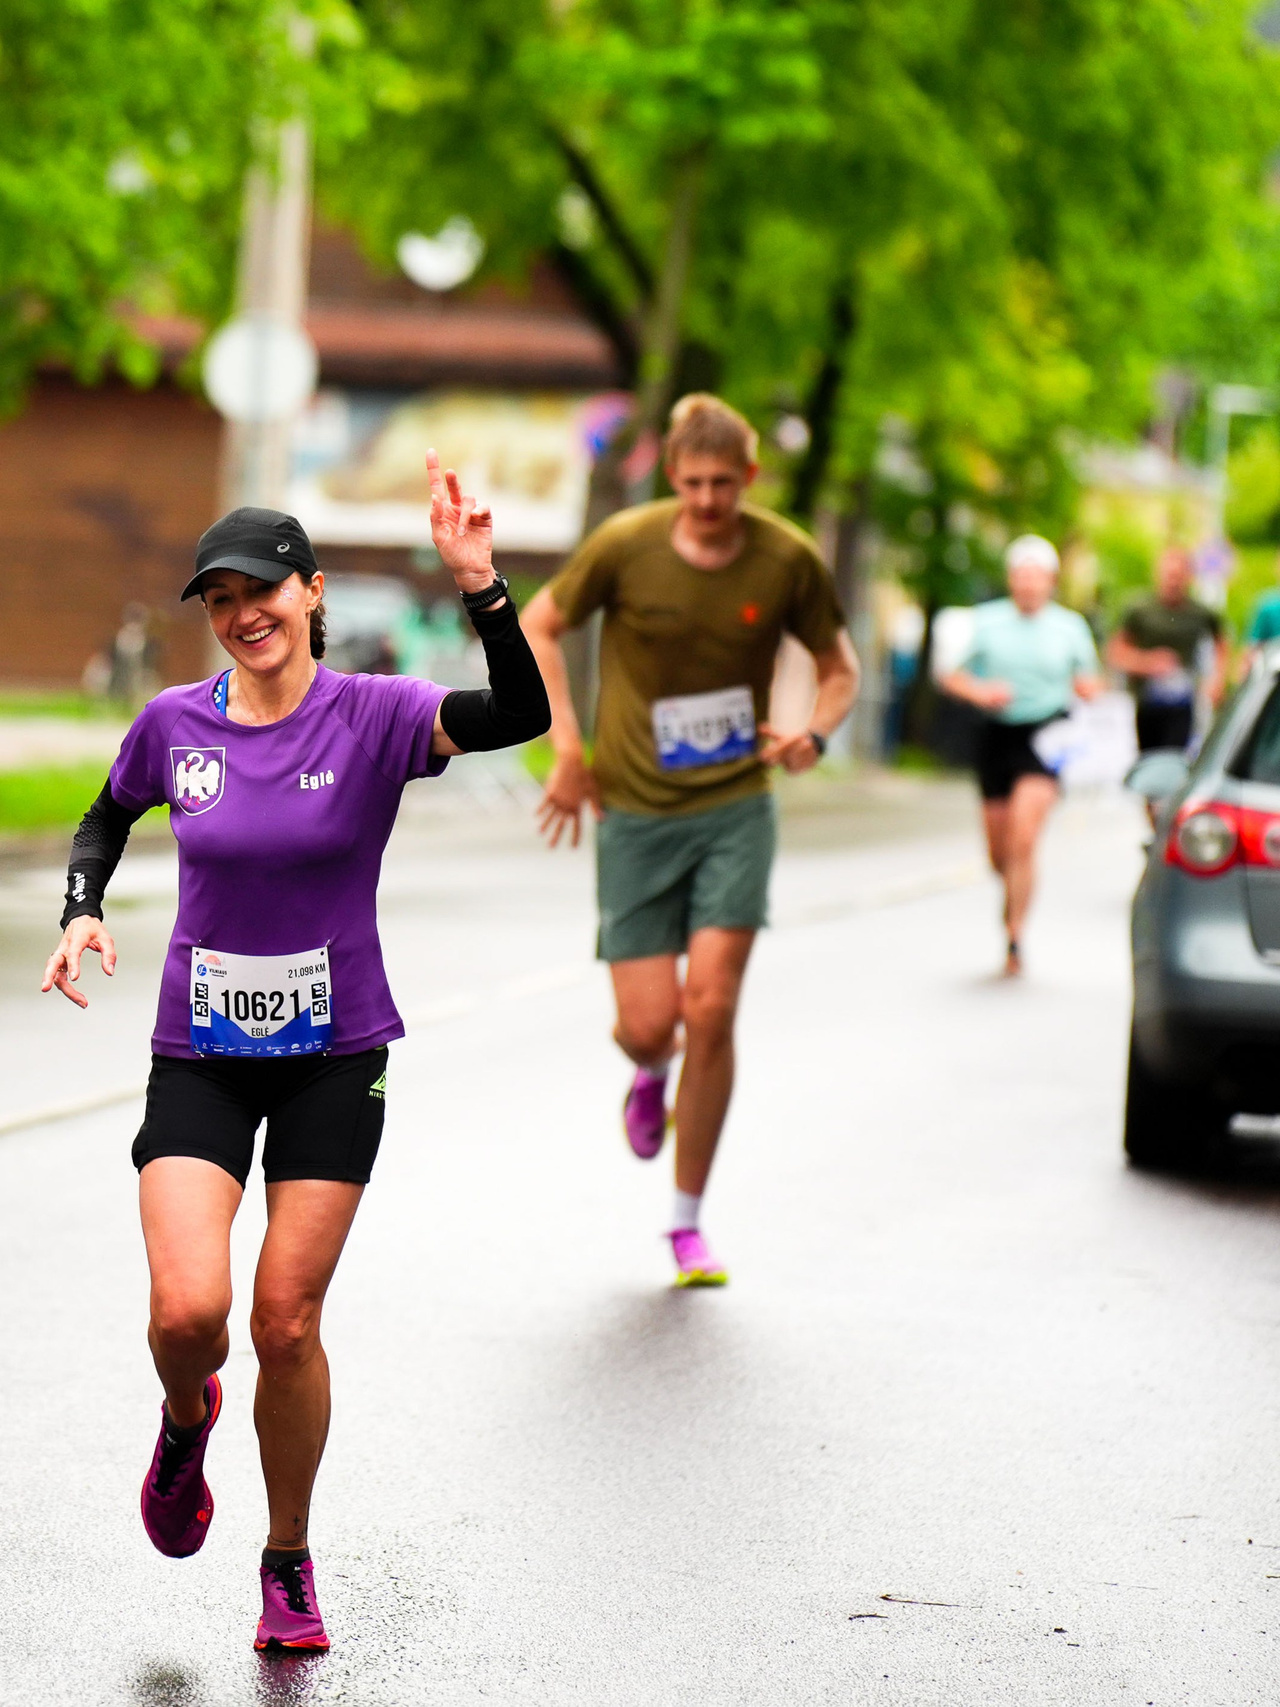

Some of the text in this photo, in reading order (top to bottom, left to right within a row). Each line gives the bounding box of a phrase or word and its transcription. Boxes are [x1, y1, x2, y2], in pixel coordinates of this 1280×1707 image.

[299, 770, 335, 790] Eglė
[315, 963, 327, 973] KM
[221, 989, 301, 1022] 10621
[251, 1026, 270, 1037] EGLĖ
